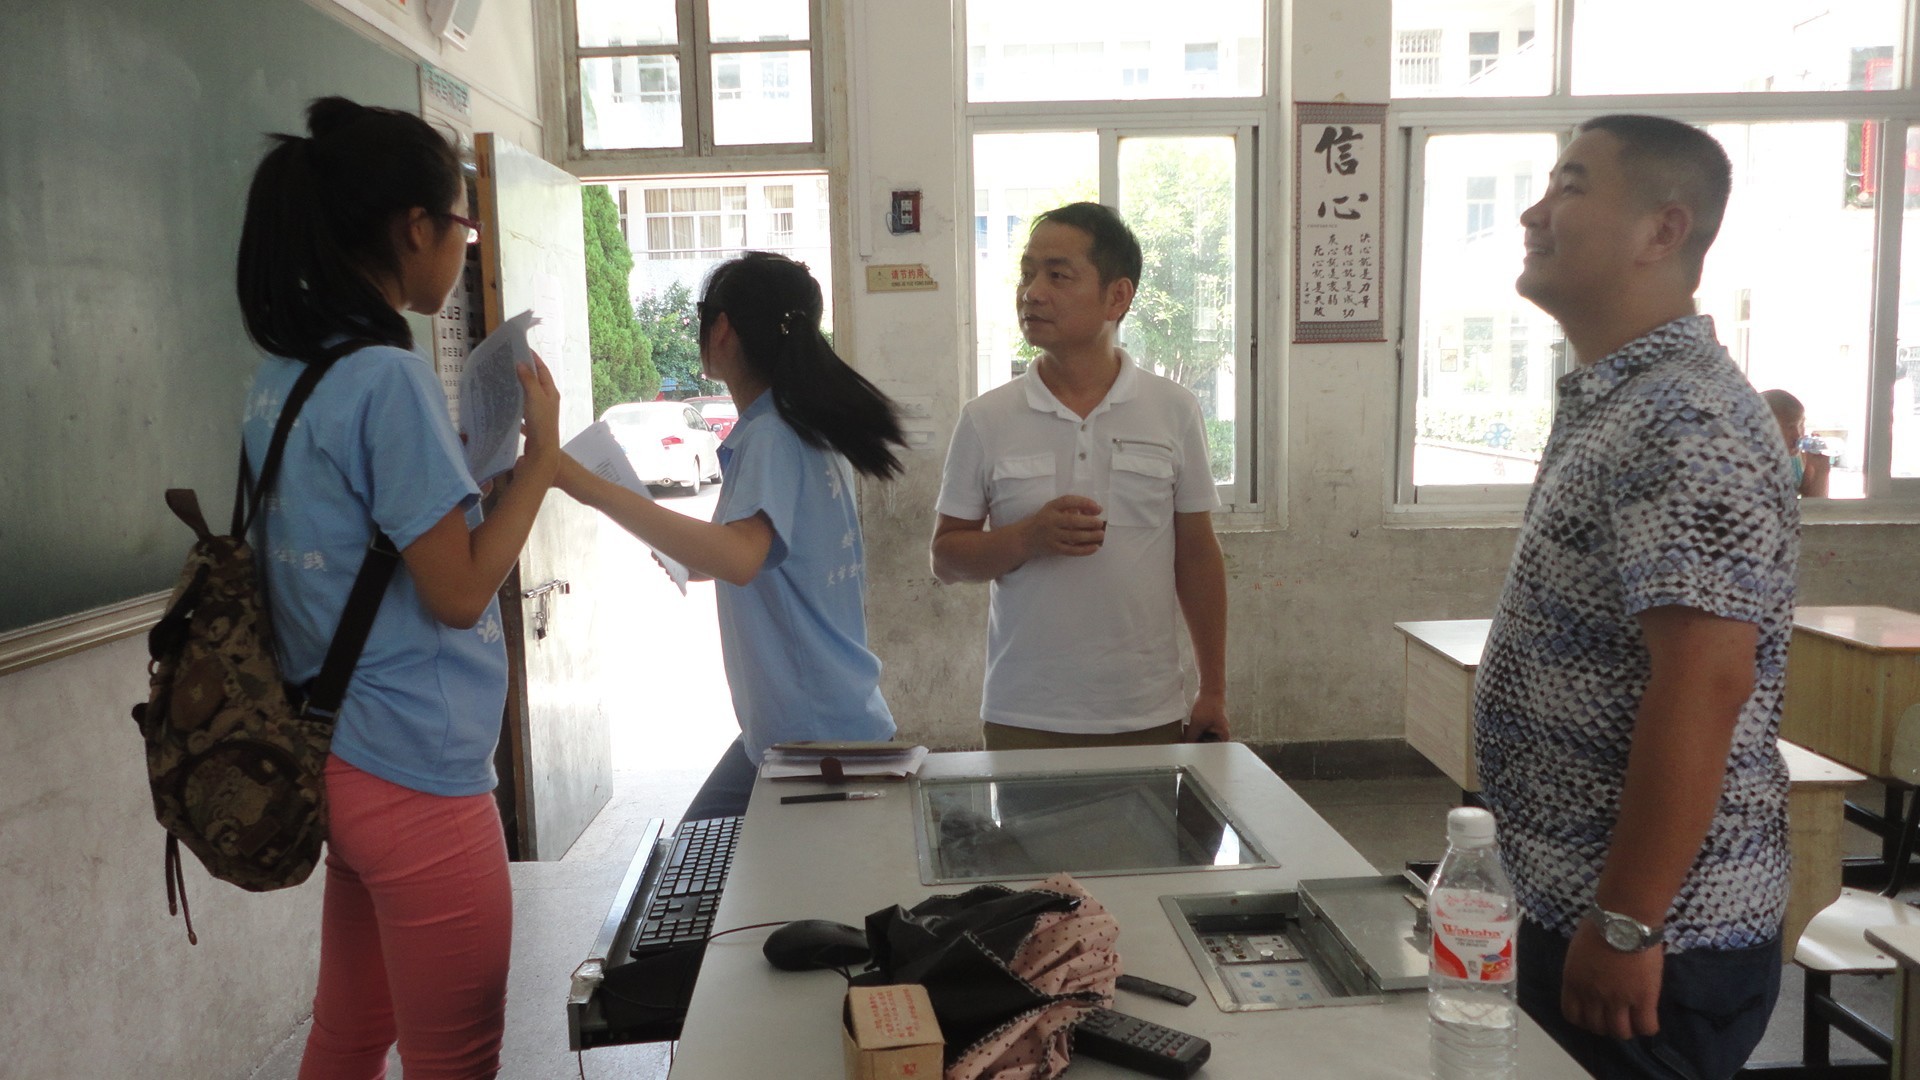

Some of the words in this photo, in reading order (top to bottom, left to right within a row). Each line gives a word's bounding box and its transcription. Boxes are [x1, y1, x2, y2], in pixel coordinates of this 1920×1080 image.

[1314, 125, 1369, 220] 信心
[891, 268, 930, 280] 请节约用
